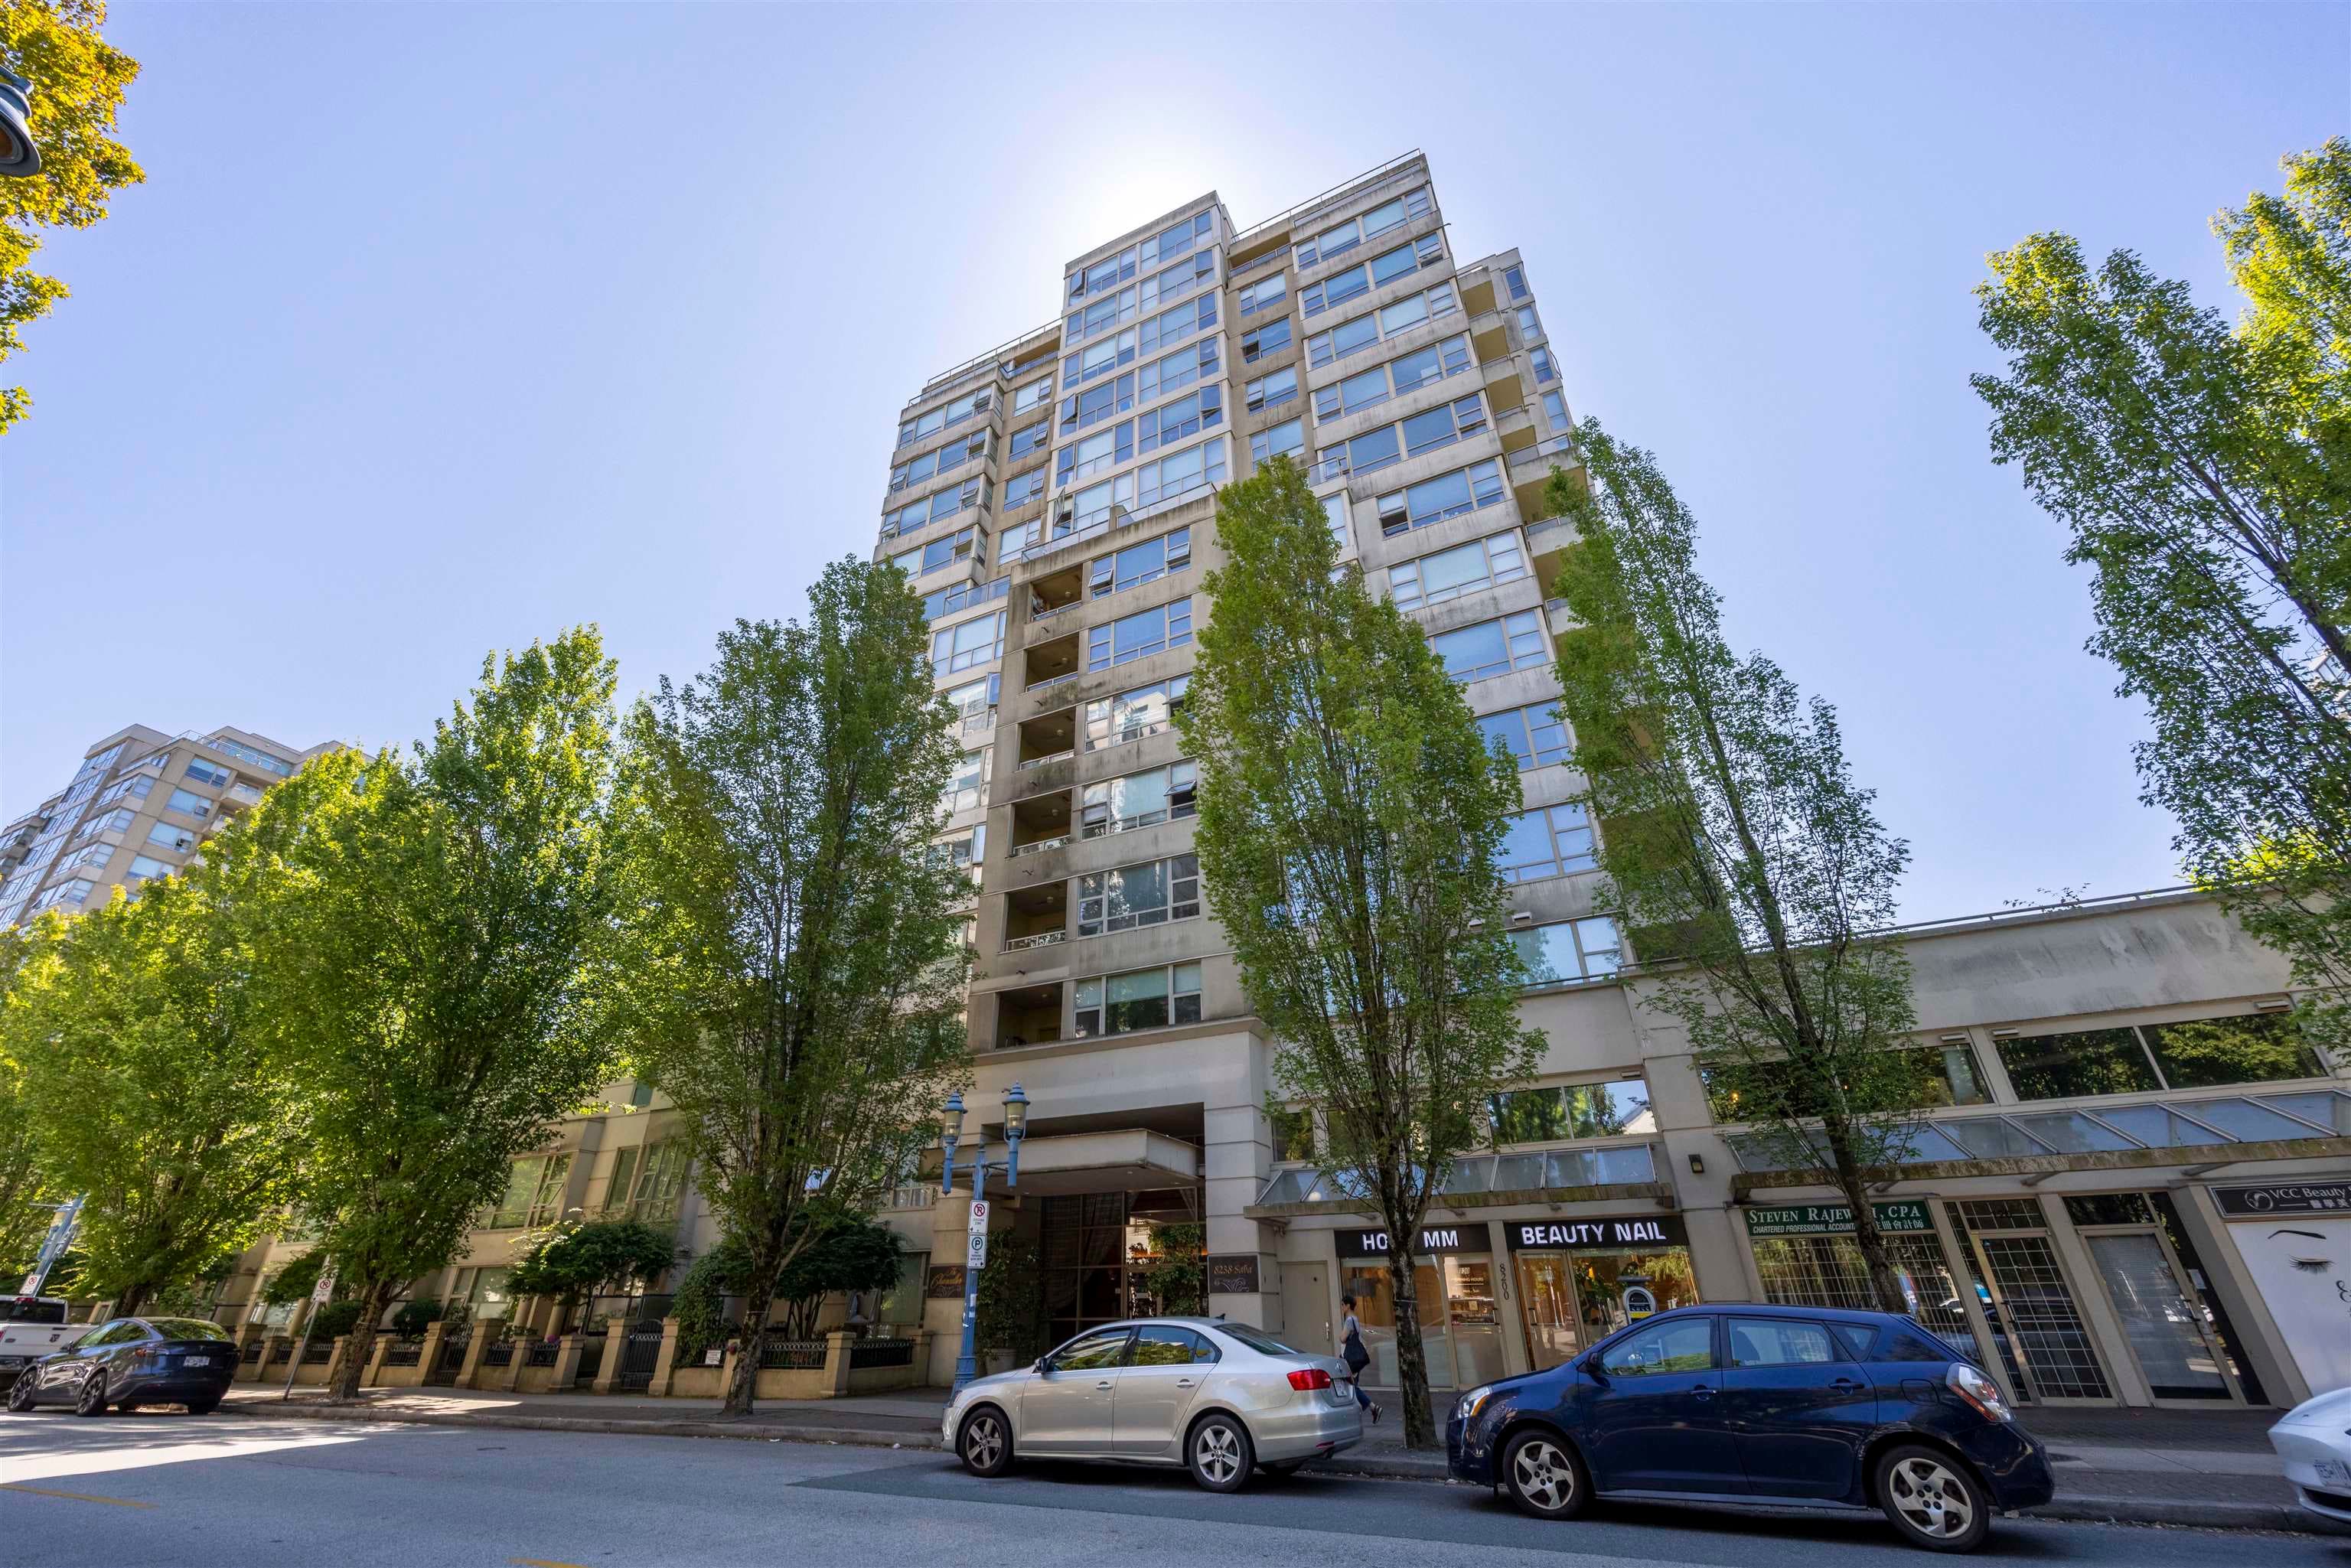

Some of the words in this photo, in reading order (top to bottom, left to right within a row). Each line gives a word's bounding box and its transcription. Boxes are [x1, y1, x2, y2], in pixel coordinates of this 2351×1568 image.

[2269, 1188, 2301, 1199] VCC
[2302, 1185, 2346, 1198] Beauty
[1749, 1209, 1798, 1224] STEVEN
[1808, 1207, 1884, 1223] RAJEWI,
[1888, 1205, 1921, 1218] CPA
[1521, 1224, 1604, 1244] BEAUTY
[1614, 1221, 1667, 1241] NAIL
[1753, 1224, 1785, 1234] CHARTERED
[1785, 1223, 1827, 1233] PROFESSIONAL
[1828, 1221, 1856, 1231] ACCOUNT
[1423, 1230, 1459, 1247] MM
